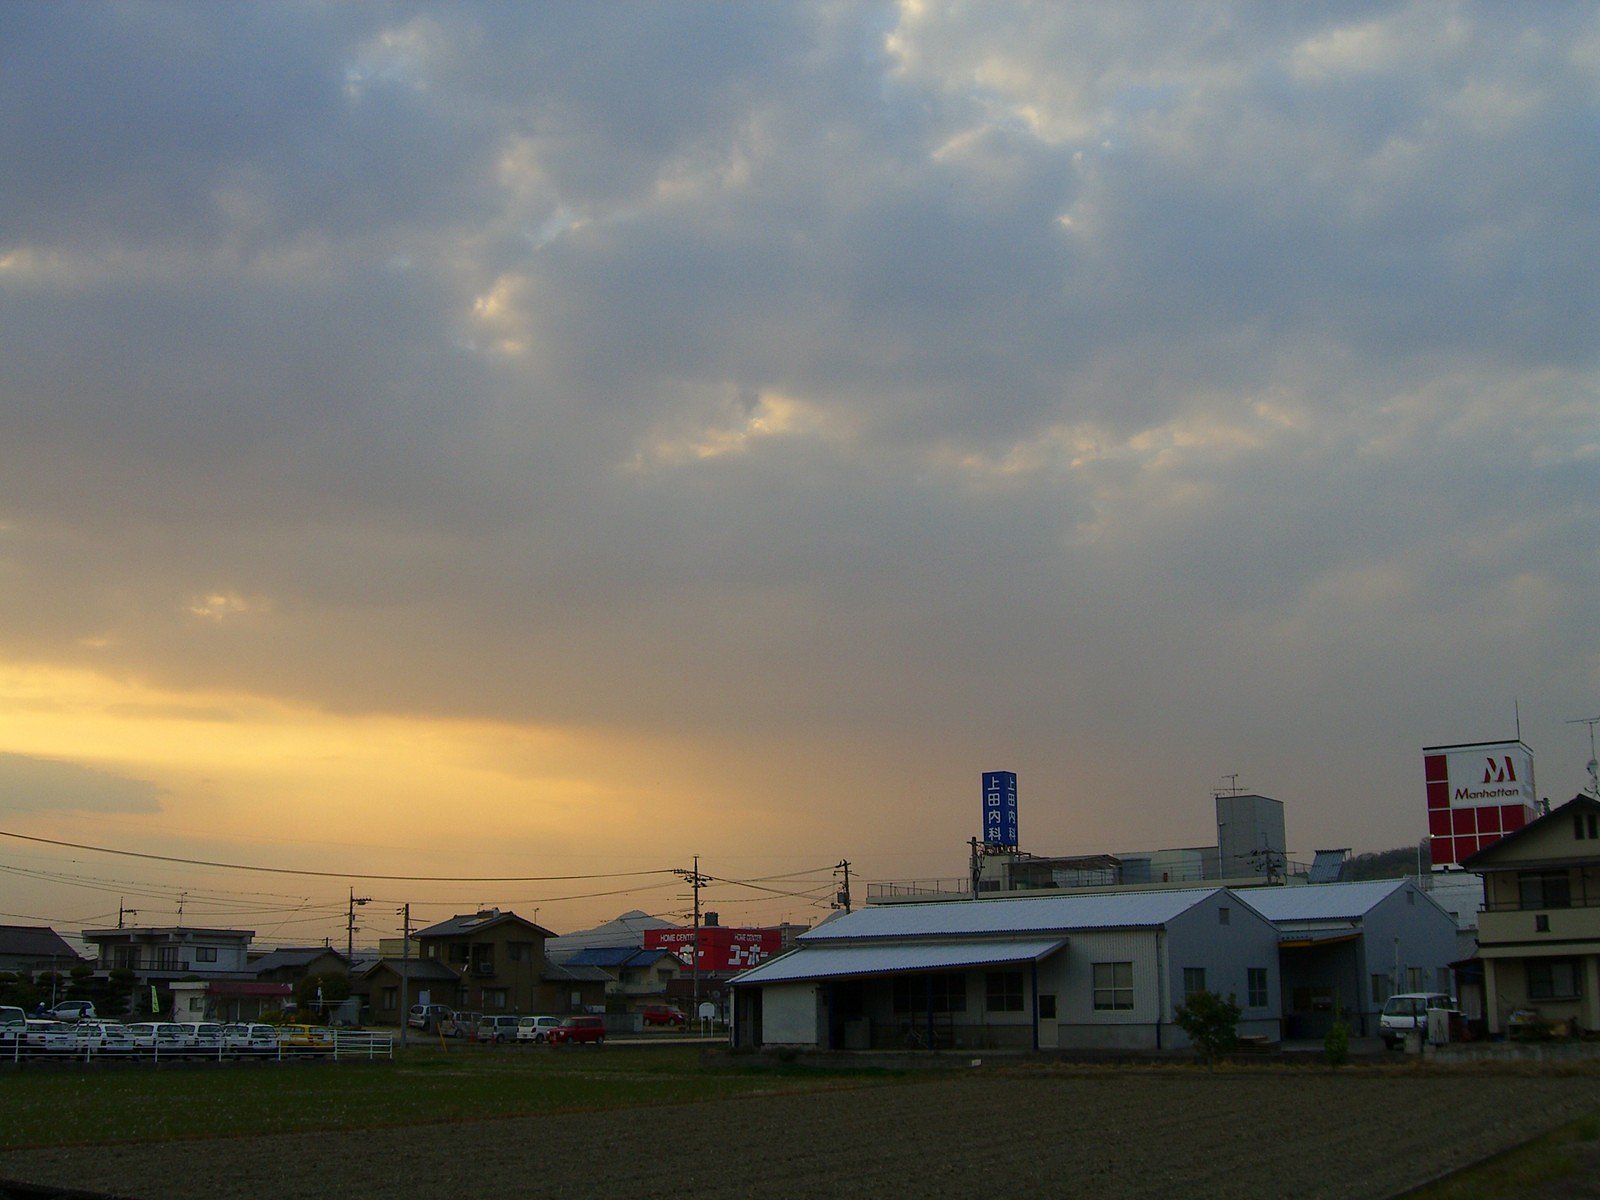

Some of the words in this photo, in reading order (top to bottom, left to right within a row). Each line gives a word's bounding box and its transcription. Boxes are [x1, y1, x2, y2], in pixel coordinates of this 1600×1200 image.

[1455, 788, 1519, 800] Manhattan
[988, 777, 1001, 840] 上田内科
[1008, 777, 1016, 840] 上田内科
[660, 933, 676, 942] HOME
[676, 933, 695, 942] CENTE
[734, 933, 746, 941] HOME
[746, 933, 763, 942] CENTER
[728, 944, 769, 965] ユーホー
